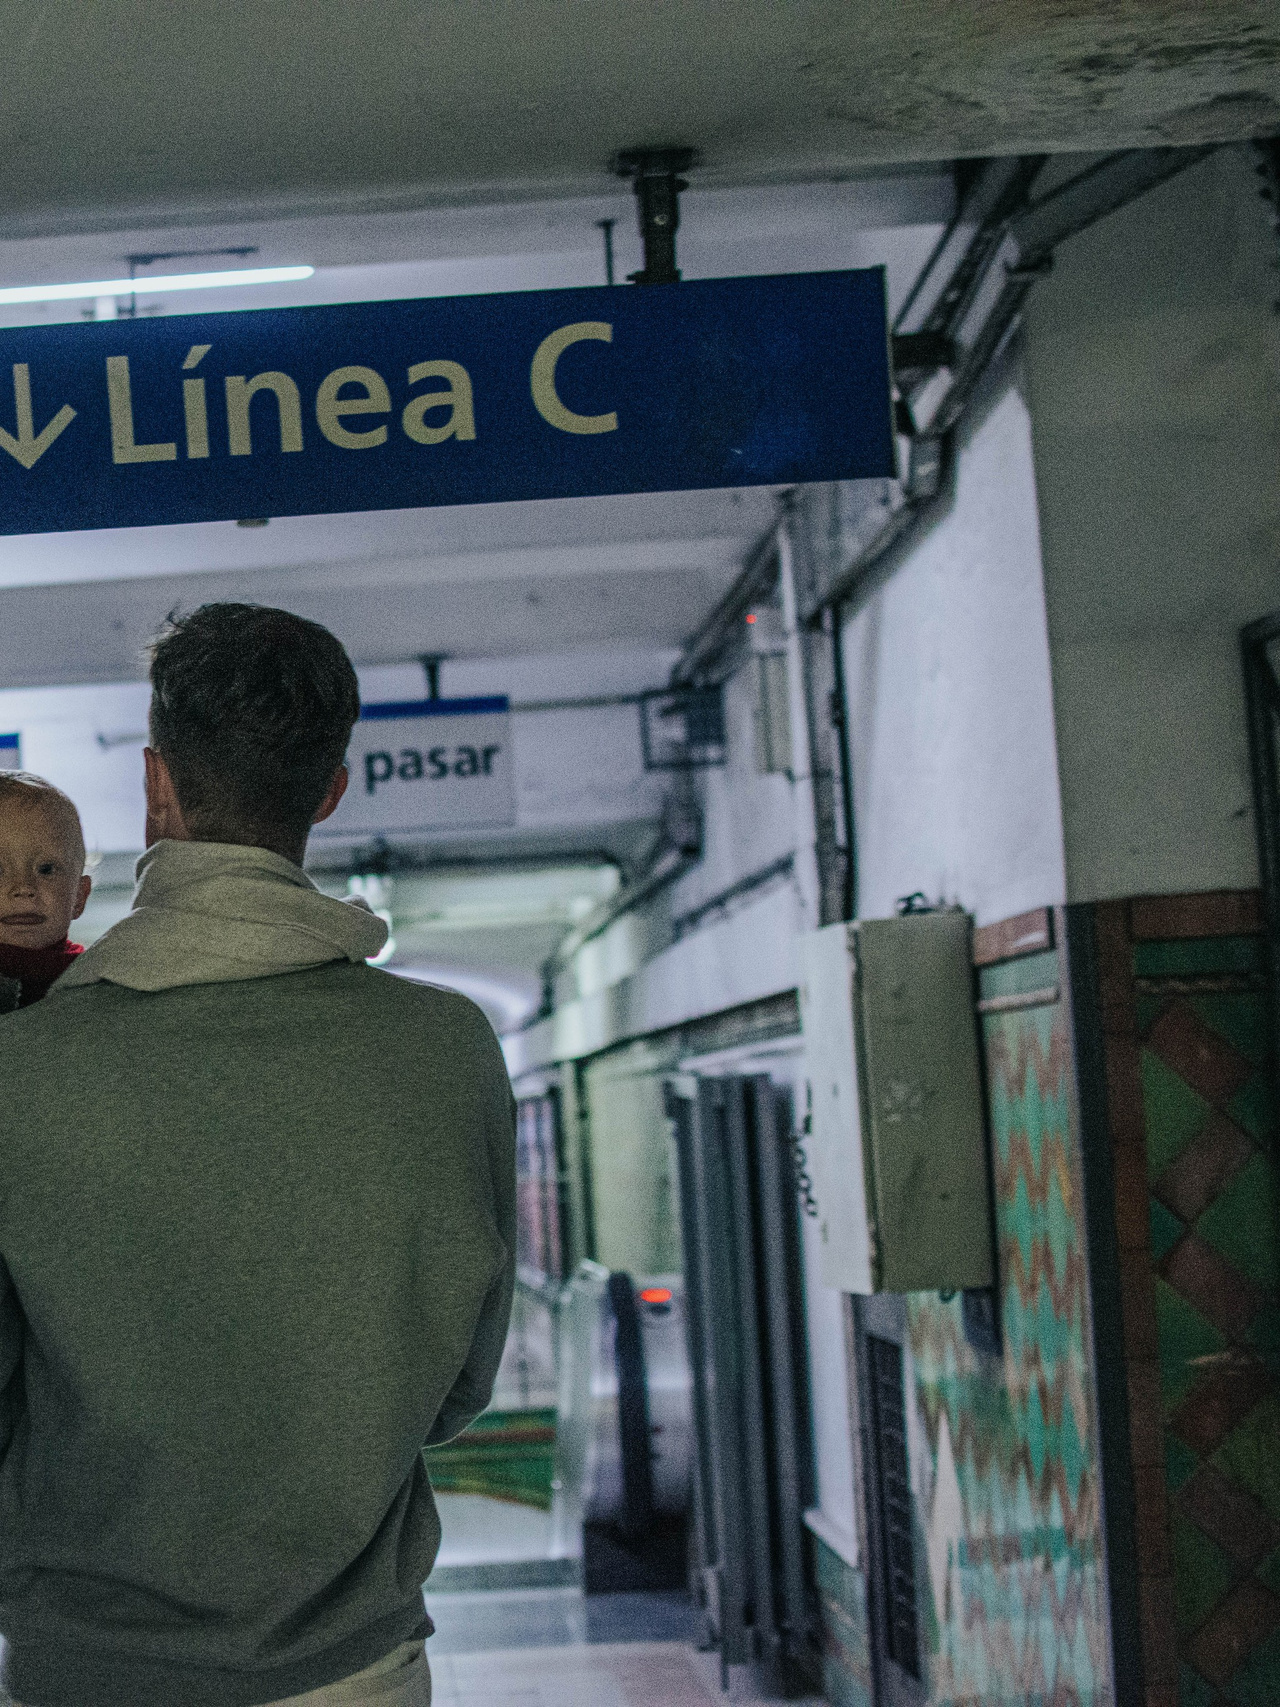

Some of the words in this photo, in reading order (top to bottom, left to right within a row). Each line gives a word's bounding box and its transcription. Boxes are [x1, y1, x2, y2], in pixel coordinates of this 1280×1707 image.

[106, 344, 477, 464] Línea
[530, 321, 618, 435] C
[364, 746, 500, 795] pasar
